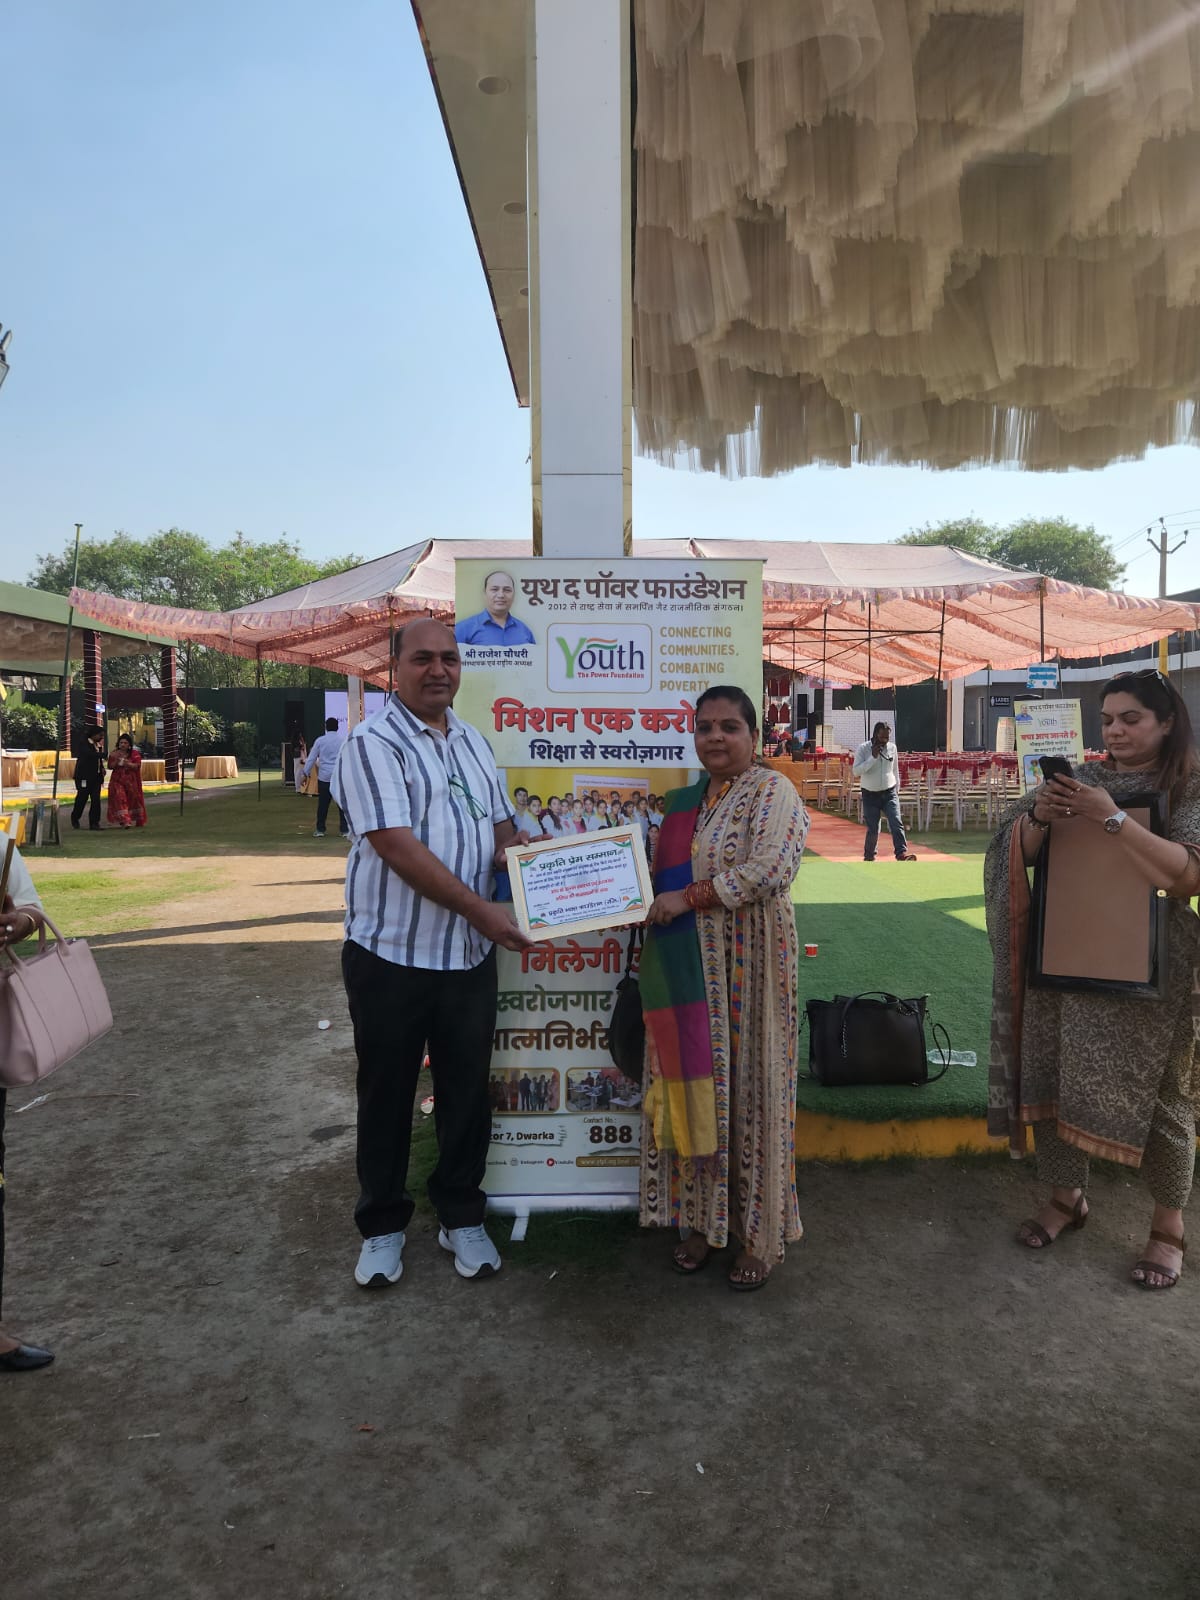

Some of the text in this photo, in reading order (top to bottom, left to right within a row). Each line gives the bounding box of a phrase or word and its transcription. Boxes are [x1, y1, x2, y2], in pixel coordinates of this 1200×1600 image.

[520, 570, 748, 606] यूथ द पॉवर फाउंडेशन
[548, 603, 568, 611] 2012
[570, 601, 577, 611] से
[597, 601, 613, 611] सेवा
[615, 602, 624, 611] में
[659, 626, 732, 638] CONNECTING
[465, 647, 476, 658] श्री
[478, 647, 501, 658] राजेश
[555, 636, 645, 679] Youth
[659, 662, 725, 675] COMBATING
[659, 679, 710, 692] POVERTY
[491, 697, 698, 735] मिशन एक करो
[529, 738, 685, 763] शिक्षा से स्वरोज़गार
[539, 857, 566, 871] प्रकृति
[568, 855, 584, 866] प्रेम
[586, 848, 617, 862] सम्मान
[520, 938, 624, 974] मिलेगी
[516, 1131, 555, 1141] Dwarka
[589, 1125, 633, 1144] 888
